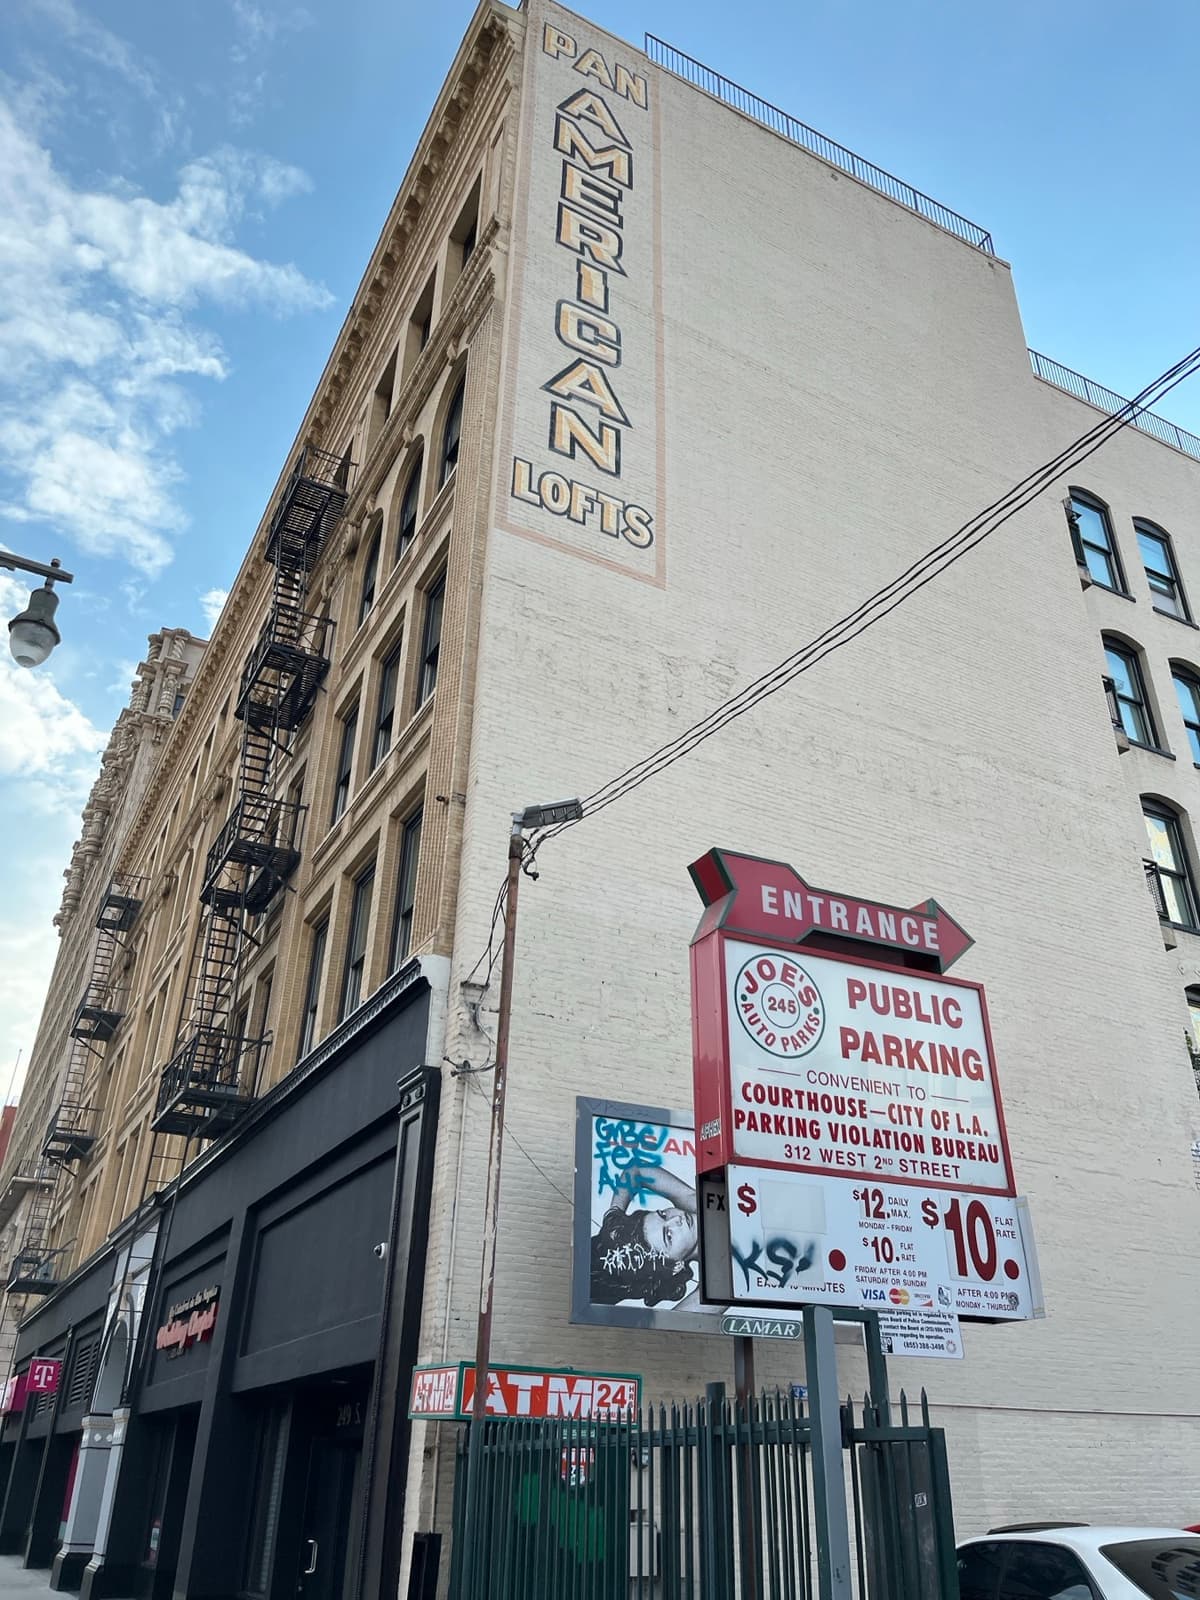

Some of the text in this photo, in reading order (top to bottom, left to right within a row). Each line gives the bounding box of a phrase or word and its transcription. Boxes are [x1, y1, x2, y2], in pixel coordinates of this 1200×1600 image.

[543, 22, 648, 111] PAN
[540, 87, 634, 479] AMERICAN
[511, 456, 654, 548] LOFTS
[761, 885, 940, 950] ENTRANCE
[743, 958, 818, 1008] JOE'S
[767, 996, 796, 1015] 245
[847, 978, 963, 1029] PUBLIC
[741, 1002, 820, 1052] AUTO PARKS
[840, 1026, 985, 1082] PARKING
[806, 1070, 926, 1101] CONVENIENT TO
[930, 1109, 950, 1132] OF
[955, 1113, 989, 1137] L.A.
[734, 1109, 1000, 1163] PARKING VIOLATION BUREAU
[784, 1144, 812, 1161] 312
[819, 1147, 866, 1168] WEST
[900, 1158, 960, 1179] STREET
[888, 1197, 910, 1207] DAILY
[891, 1209, 911, 1219] MAX.
[995, 1217, 1014, 1227] FLAT
[859, 1221, 886, 1231] MONDAY
[891, 1224, 913, 1232] FRIDAY
[996, 1229, 1017, 1240] RATE
[900, 1243, 914, 1251] FLAT
[901, 1254, 917, 1262] RATE
[855, 1266, 877, 1274] FRIDAY
[880, 1268, 901, 1276] AFTER
[856, 1275, 927, 1287] SATURDAY OR SUNDAY
[861, 1289, 886, 1300] VISA
[958, 1288, 981, 1299] AFTER
[956, 1300, 980, 1309] MONDAY
[729, 1319, 796, 1336] LAMAR
[465, 1371, 592, 1418] ATM
[597, 1383, 627, 1408] 24
